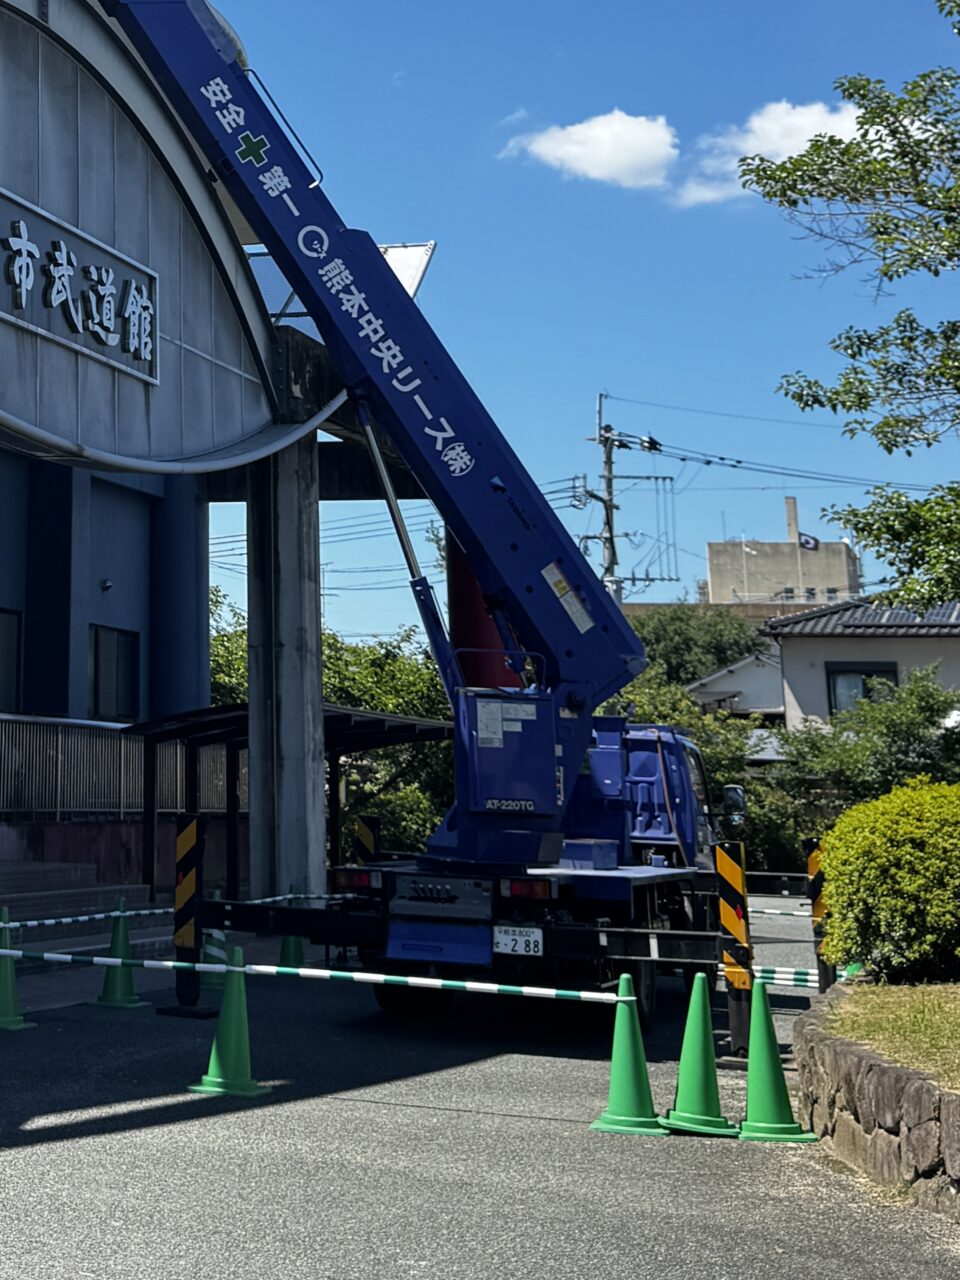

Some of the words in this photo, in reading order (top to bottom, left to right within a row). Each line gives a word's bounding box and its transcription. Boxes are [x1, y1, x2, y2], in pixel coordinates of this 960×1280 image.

[200, 77, 245, 134] 安全
[258, 165, 300, 217] 第一
[485, 799, 535, 811] AT-220TG
